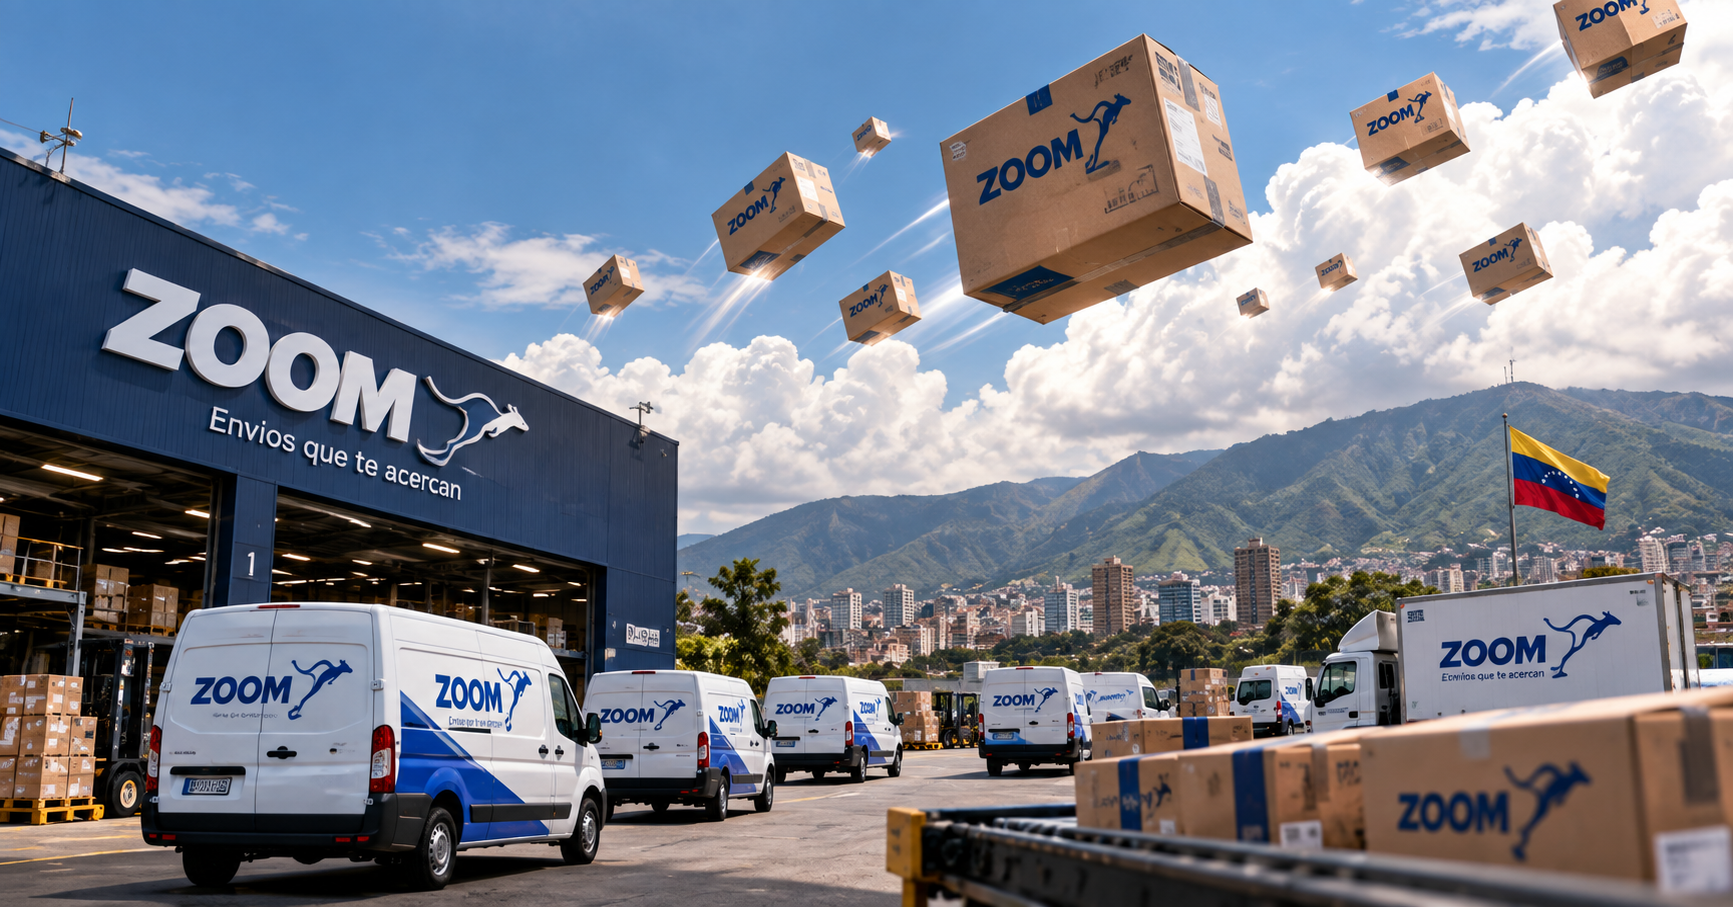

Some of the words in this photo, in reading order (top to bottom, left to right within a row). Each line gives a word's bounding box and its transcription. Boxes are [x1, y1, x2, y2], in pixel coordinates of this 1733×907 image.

[1366, 103, 1415, 136] ZOOM
[976, 128, 1084, 206] ZOOM
[727, 195, 769, 236] ZOOM
[1472, 248, 1509, 273] ZOOM
[101, 267, 417, 443] ZOOM
[209, 406, 296, 453] Envios
[303, 439, 348, 467] que
[355, 451, 378, 477] te
[384, 464, 462, 501] acercan
[247, 551, 255, 577] 1
[1439, 634, 1547, 668] ZOOM
[190, 675, 293, 705] ZOOM
[1477, 672, 1495, 681] que
[1496, 671, 1507, 679] te
[1508, 670, 1545, 679] acercan
[435, 673, 503, 713] ZOOM
[992, 694, 1035, 707] ZOOM
[600, 708, 655, 724] ZOOM
[718, 705, 740, 723] ZOOM
[775, 703, 815, 715] ZOOM
[1397, 790, 1510, 835] ZOOM
